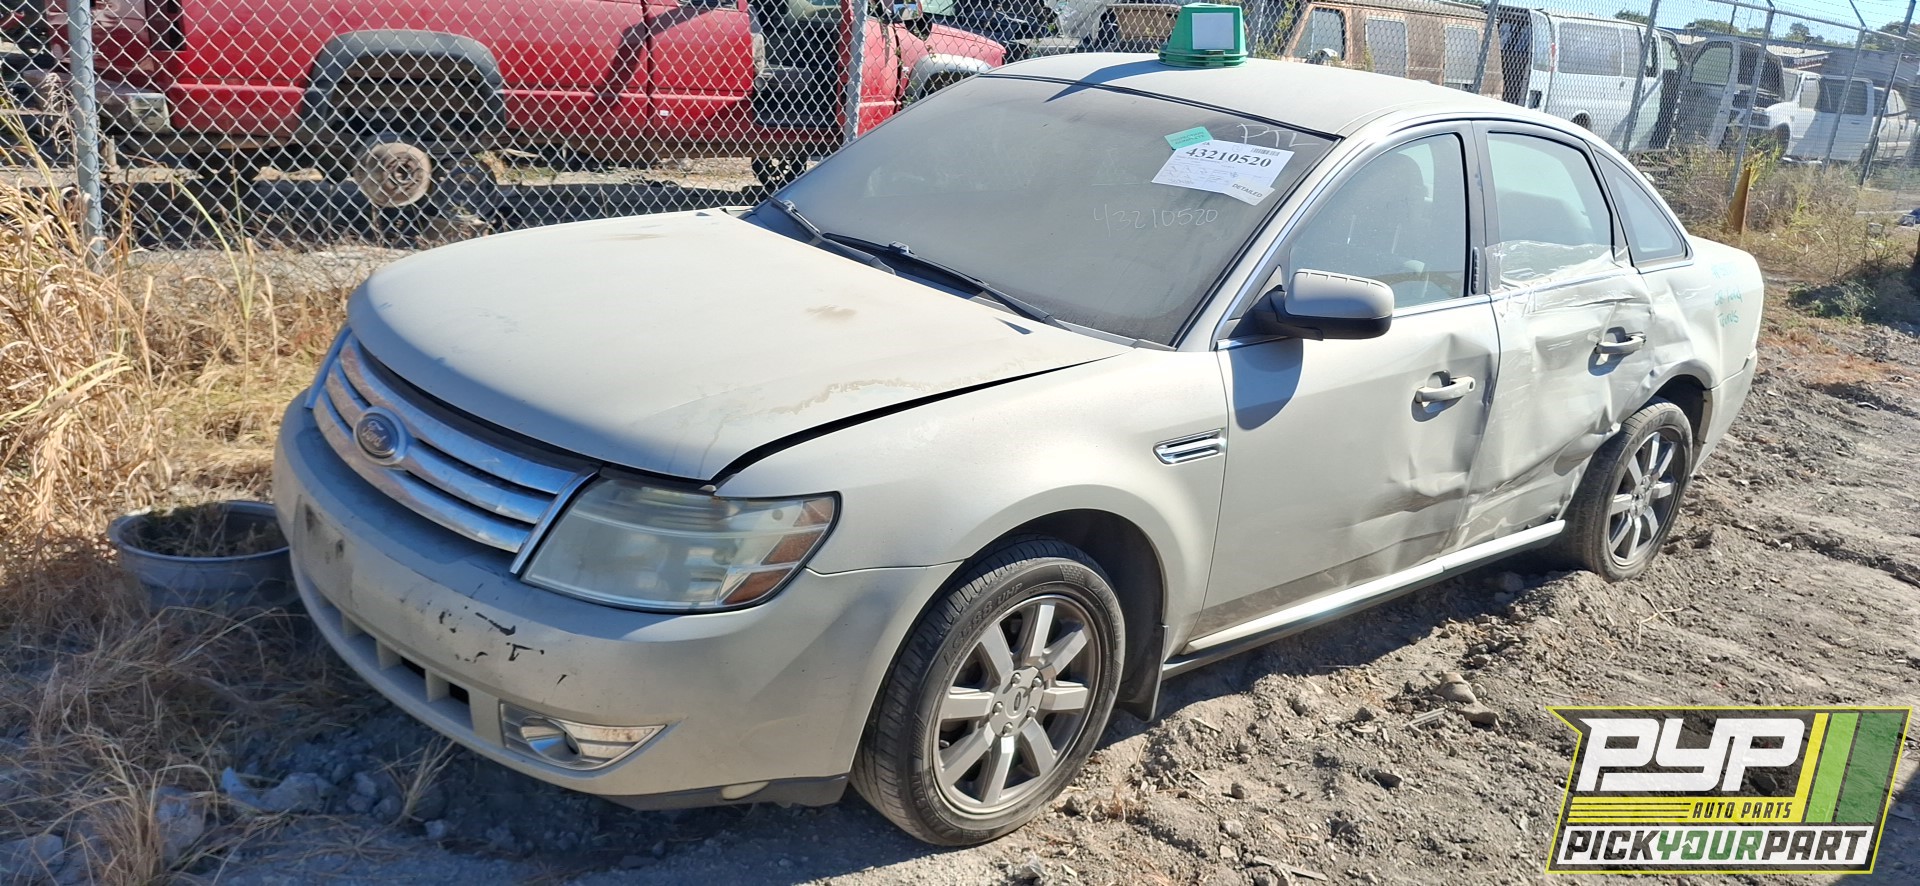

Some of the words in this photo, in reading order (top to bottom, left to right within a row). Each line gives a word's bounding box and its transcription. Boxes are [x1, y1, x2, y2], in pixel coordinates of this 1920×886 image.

[1186, 147, 1272, 168] 43210520
[1231, 183, 1263, 199] DETAILED
[1093, 203, 1219, 238] 43210520
[361, 420, 387, 448] Ford
